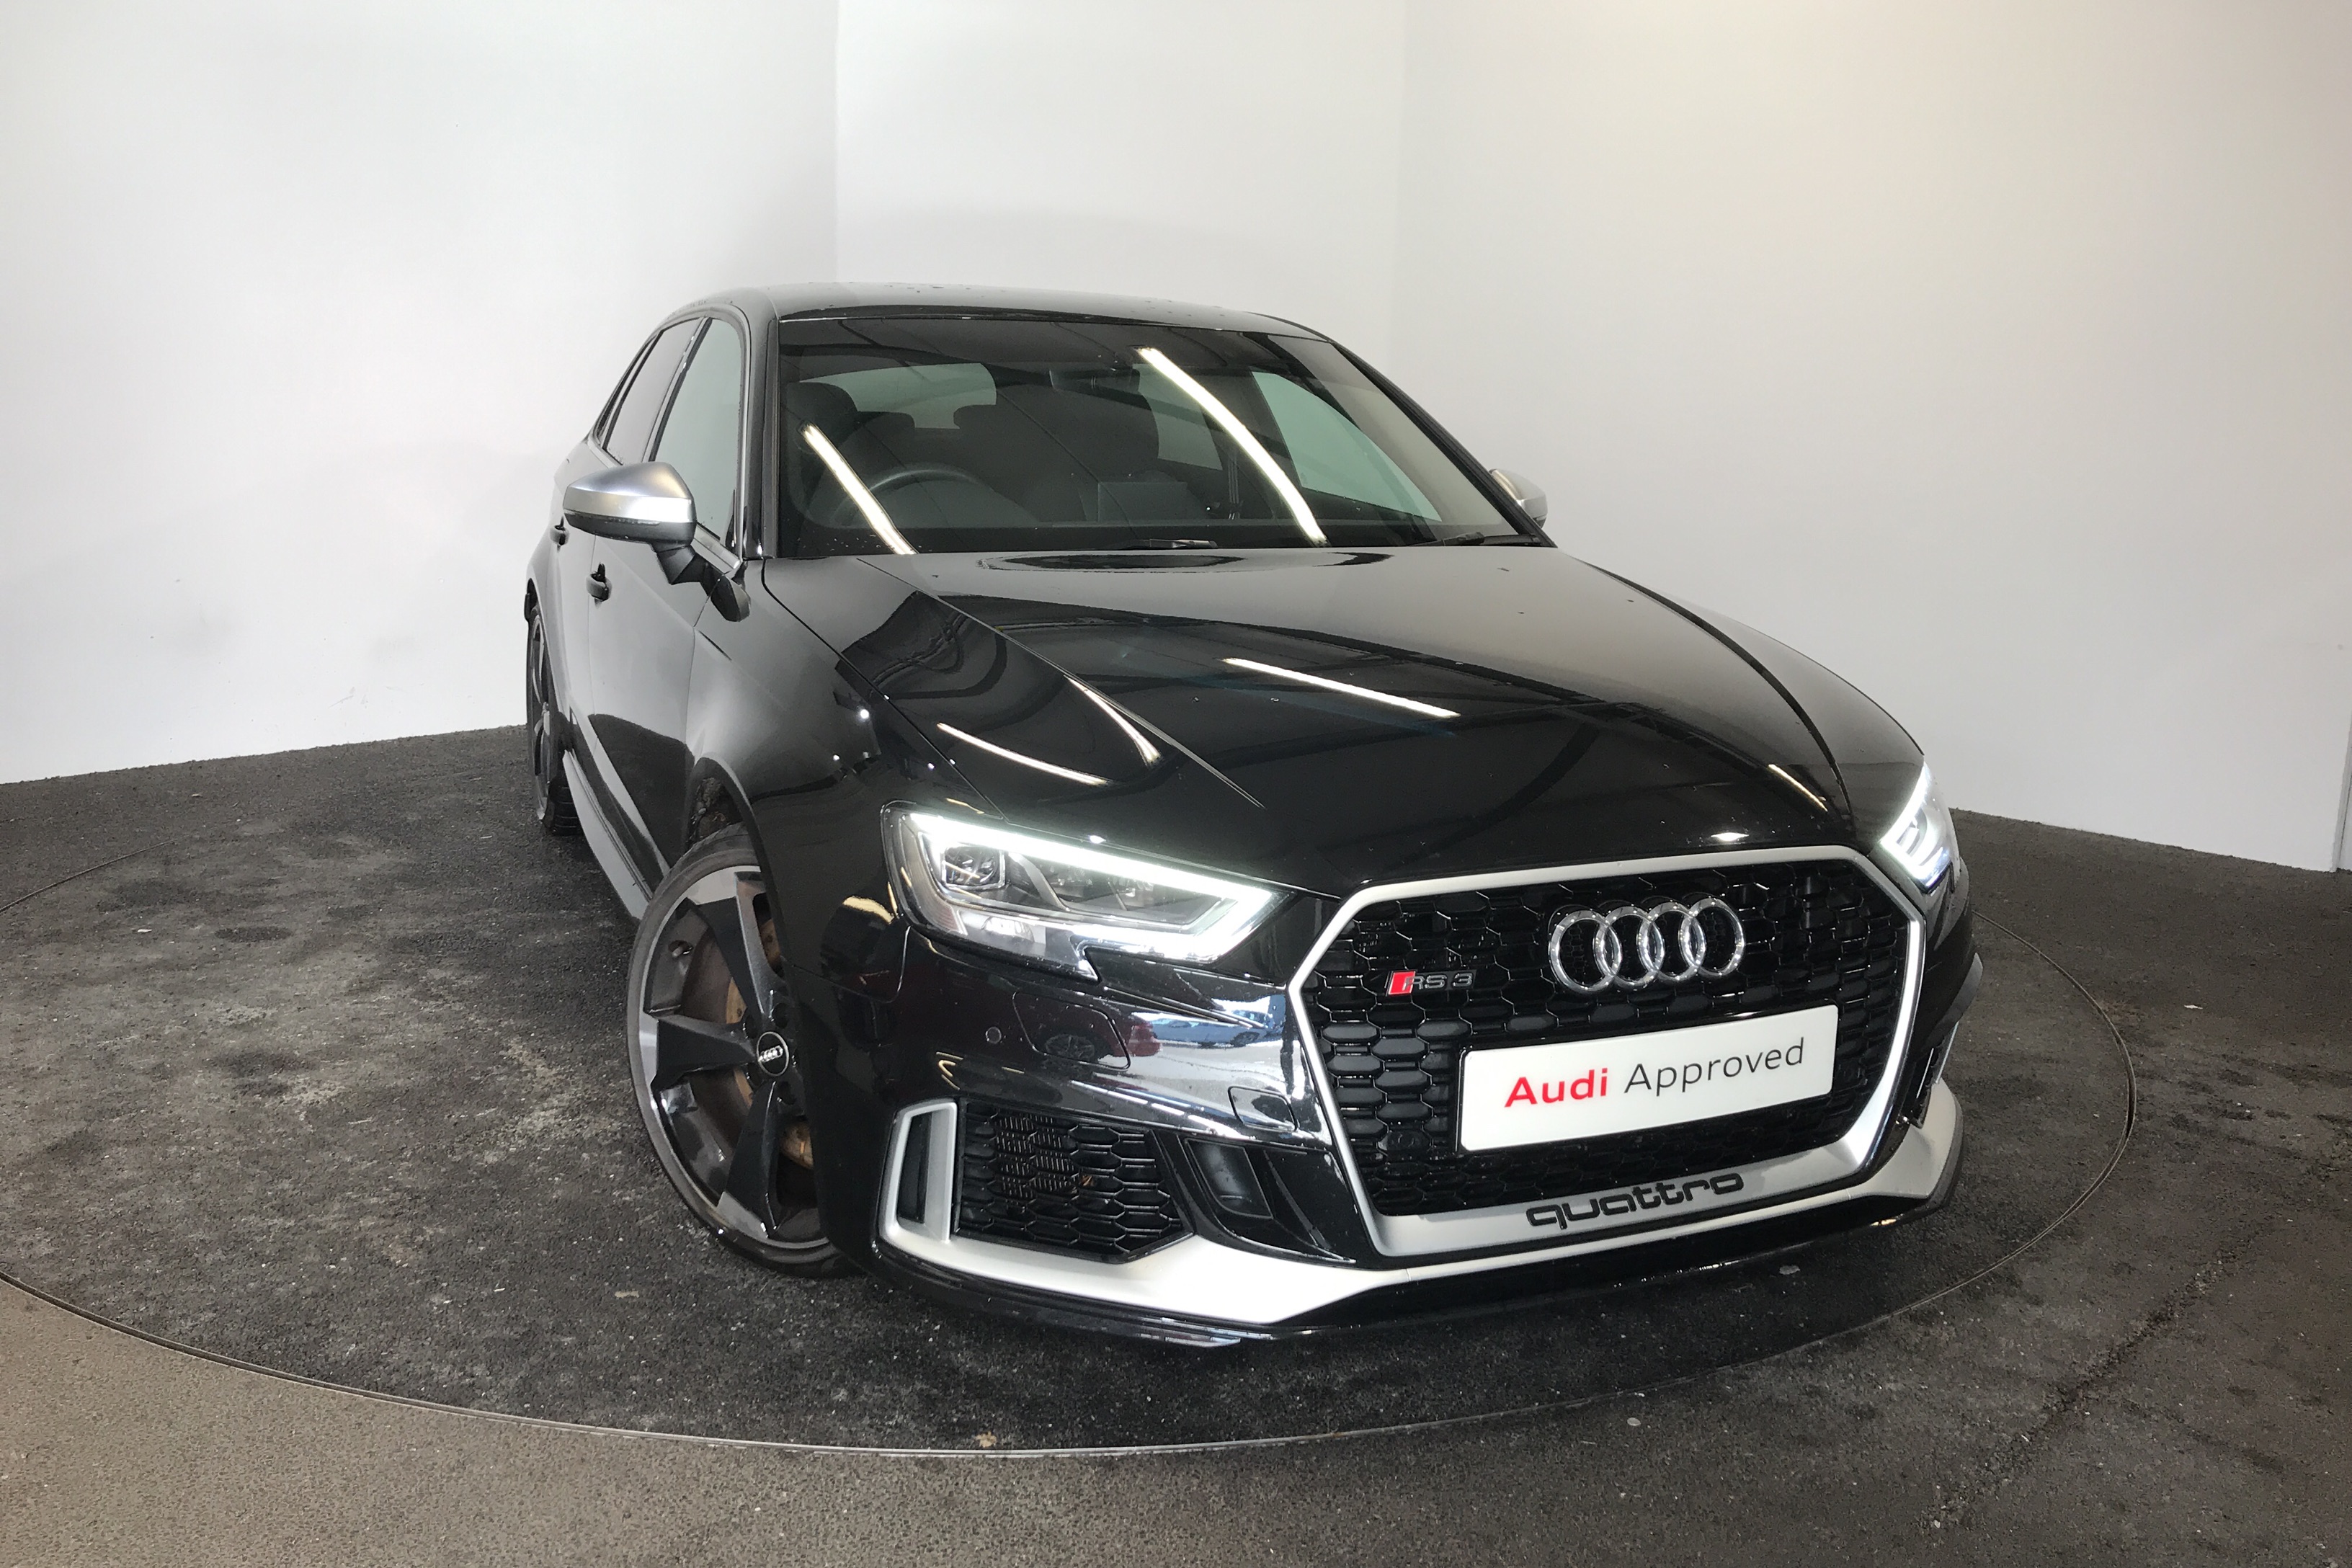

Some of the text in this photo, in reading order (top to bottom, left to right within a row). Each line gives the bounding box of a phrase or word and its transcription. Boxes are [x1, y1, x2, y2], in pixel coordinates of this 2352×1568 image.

[1504, 1036, 1804, 1108] Audi Approved
[1525, 1172, 1745, 1230] quattro
